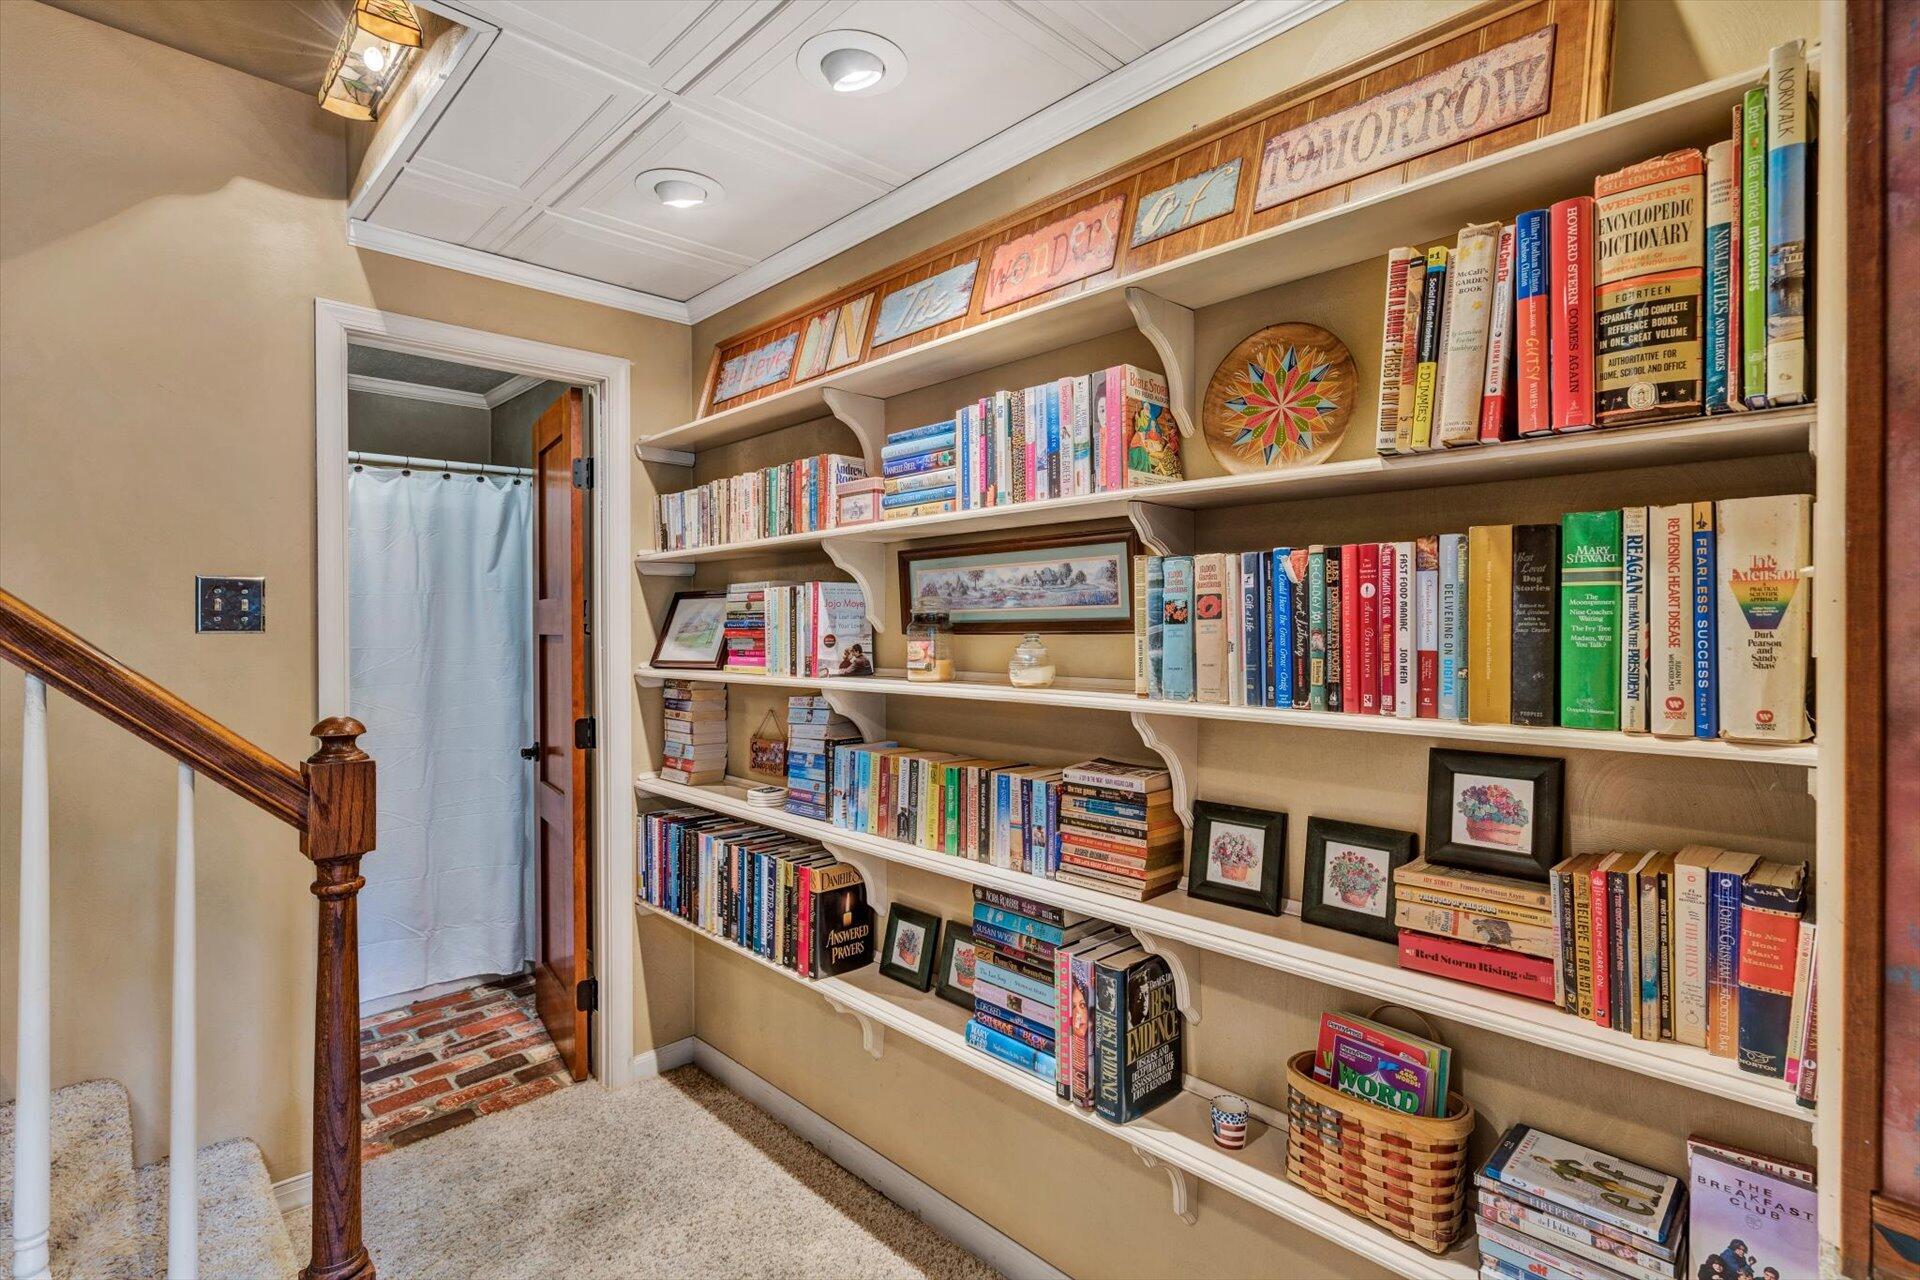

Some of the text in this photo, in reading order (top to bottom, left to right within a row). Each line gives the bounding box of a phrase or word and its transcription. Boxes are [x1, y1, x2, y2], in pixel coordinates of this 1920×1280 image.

[1777, 68, 1795, 138] NORWALK
[1264, 55, 1545, 191] TOMORROW
[1139, 167, 1234, 235] of
[1602, 184, 1691, 211] WEBSTER'S
[1599, 197, 1694, 235] ENCYCLOPEDIC
[1748, 155, 1763, 291] flea market makeovers
[1501, 233, 1511, 252] Chix
[1599, 220, 1692, 260] DICTIONARY
[1500, 252, 1510, 268] Can
[1530, 217, 1541, 293] Hillary Rodham Clinton
[1456, 276, 1488, 287] GARDEN
[1458, 267, 1488, 278] McCall's
[1498, 269, 1508, 282] Fix
[1458, 286, 1482, 294] BOOK
[1567, 207, 1579, 393] HOWARD STERN COMES AGAIN
[1616, 286, 1671, 303] FOURTEEN
[1713, 230, 1729, 371] NAVAL BATTLES AND HEROES
[1422, 277, 1438, 357] Social Media Marketing
[1600, 301, 1688, 325] SEPARATE AND COMPLETE
[1608, 317, 1678, 336] REFERENCE BOOKS
[1610, 336, 1626, 347] ONE
[1628, 332, 1653, 344] GREAT
[1655, 327, 1688, 339] VOLUME
[1492, 340, 1501, 364] NORMA
[1608, 349, 1677, 367] AUTHORITATIVE FOR
[1491, 367, 1500, 385] VALLY
[1416, 373, 1431, 422] DUMMIES
[1062, 461, 1071, 483] GREEN
[1567, 553, 1617, 564] STEWART
[1576, 545, 1611, 555] MARY
[1626, 534, 1644, 595] REAGAN
[1696, 538, 1707, 613] FEARLESS
[1731, 568, 1799, 583] Extension
[1515, 584, 1550, 592] Stories
[1522, 575, 1543, 583] Dog
[1667, 518, 1681, 648] REVERSING HEART DISEASE
[1400, 554, 1408, 632] FAST FOOD MANIAC
[1629, 595, 1638, 610] THE
[825, 599, 865, 610] Jojo Moye
[1444, 584, 1454, 638] DELIVERING
[1627, 611, 1639, 632] MAN,
[1364, 602, 1376, 677] Ann Brashares
[1570, 635, 1596, 643] Madam,
[1628, 633, 1637, 648] THE
[1748, 639, 1782, 648] Pearson
[1754, 631, 1774, 639] Durk
[1444, 643, 1454, 655] ON
[1697, 620, 1708, 688] SUCCESS
[1751, 654, 1778, 663] Sandy
[1332, 649, 1340, 683] WORTH
[1400, 648, 1408, 684] JON HEIN
[1627, 649, 1640, 701] PRESIDENT
[1752, 662, 1776, 670] Shaw
[1444, 659, 1454, 696] DIGITAL
[1754, 888, 1778, 897] LANE
[826, 925, 870, 948] ANSWERED
[976, 924, 995, 936] SUSAN
[1686, 922, 1699, 944] THE
[1743, 929, 1787, 943] The New
[832, 941, 864, 964] PRAYERS
[1577, 903, 1590, 993] BELIEVE IT OR NOT
[1718, 905, 1735, 978] JOHN GRISHAM
[1414, 948, 1518, 980] Red Storm Rising
[1685, 945, 1699, 977] RULES
[1743, 956, 1784, 970] Manual
[1597, 975, 1604, 987] ON
[1718, 993, 1731, 1050] ROOSTER BAR
[1127, 1010, 1179, 1066] EVIDENCE
[1101, 1015, 1118, 1103] BEST EVIDENCE
[1157, 1045, 1169, 1057] AND
[1739, 1059, 1777, 1072] NORTON
[1339, 1061, 1419, 1113] WORD
[1736, 1156, 1812, 1182] CRUISE
[1697, 1175, 1814, 1220] BREAKFAST
[1735, 1179, 1773, 1197] THE
[1729, 1198, 1780, 1220] CLUB
[1528, 1263, 1549, 1276] elf
